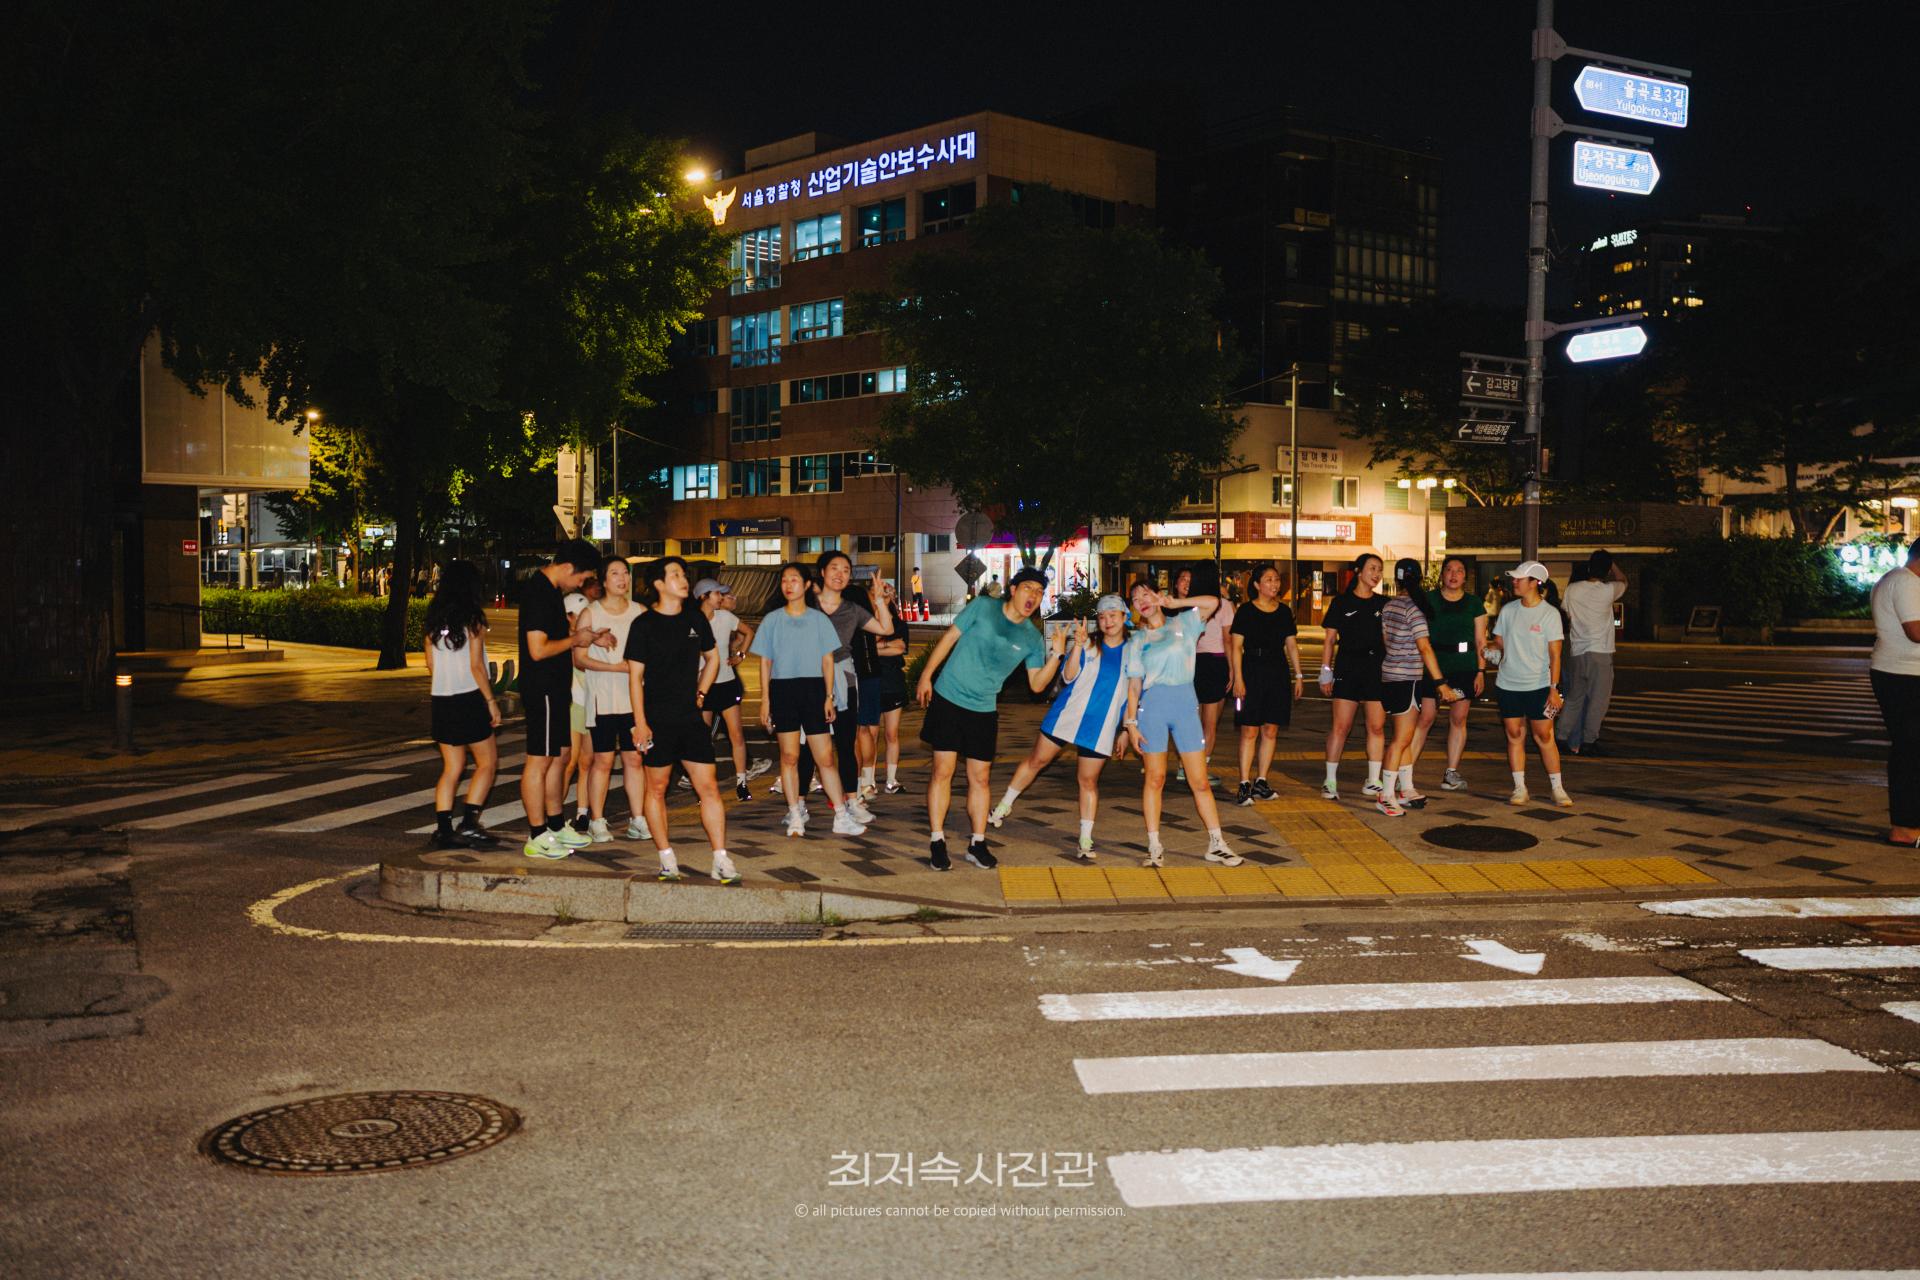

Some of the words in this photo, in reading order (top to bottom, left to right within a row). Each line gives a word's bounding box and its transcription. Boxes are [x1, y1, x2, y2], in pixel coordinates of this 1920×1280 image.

[1624, 79, 1684, 108] 율곡로3길
[1616, 98, 1661, 117] Yulgok-ro
[1663, 107, 1683, 121] 3-gil
[741, 178, 801, 208] 서울경찰청
[807, 130, 977, 197] 산업기술안보수사대
[1581, 148, 1628, 171] 우정국로
[1579, 167, 1640, 187] Ujeongguk-ro
[1486, 376, 1518, 392] 감고당길
